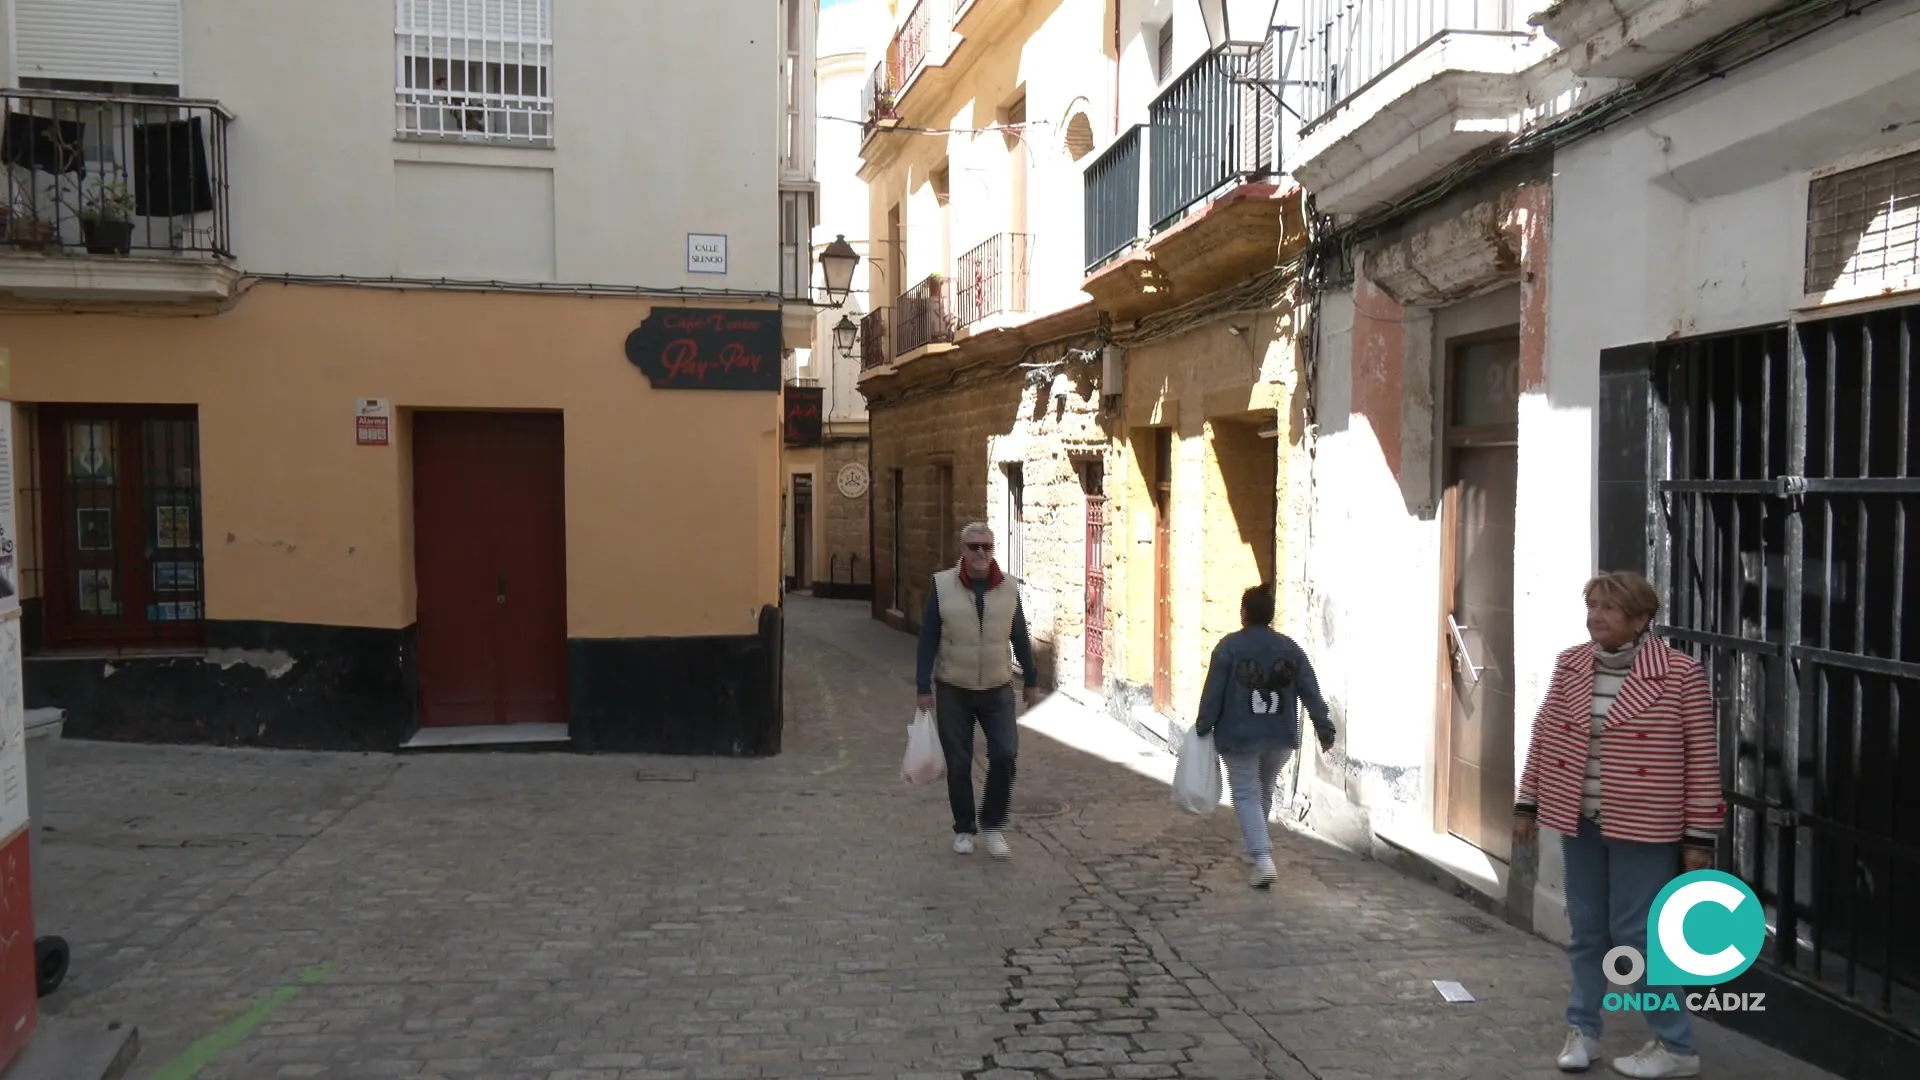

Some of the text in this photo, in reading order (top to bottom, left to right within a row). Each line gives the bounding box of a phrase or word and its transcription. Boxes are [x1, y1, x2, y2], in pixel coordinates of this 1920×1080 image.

[695, 244, 719, 252] CALLE
[692, 255, 723, 263] SILENCIO
[359, 416, 387, 425] Alarma
